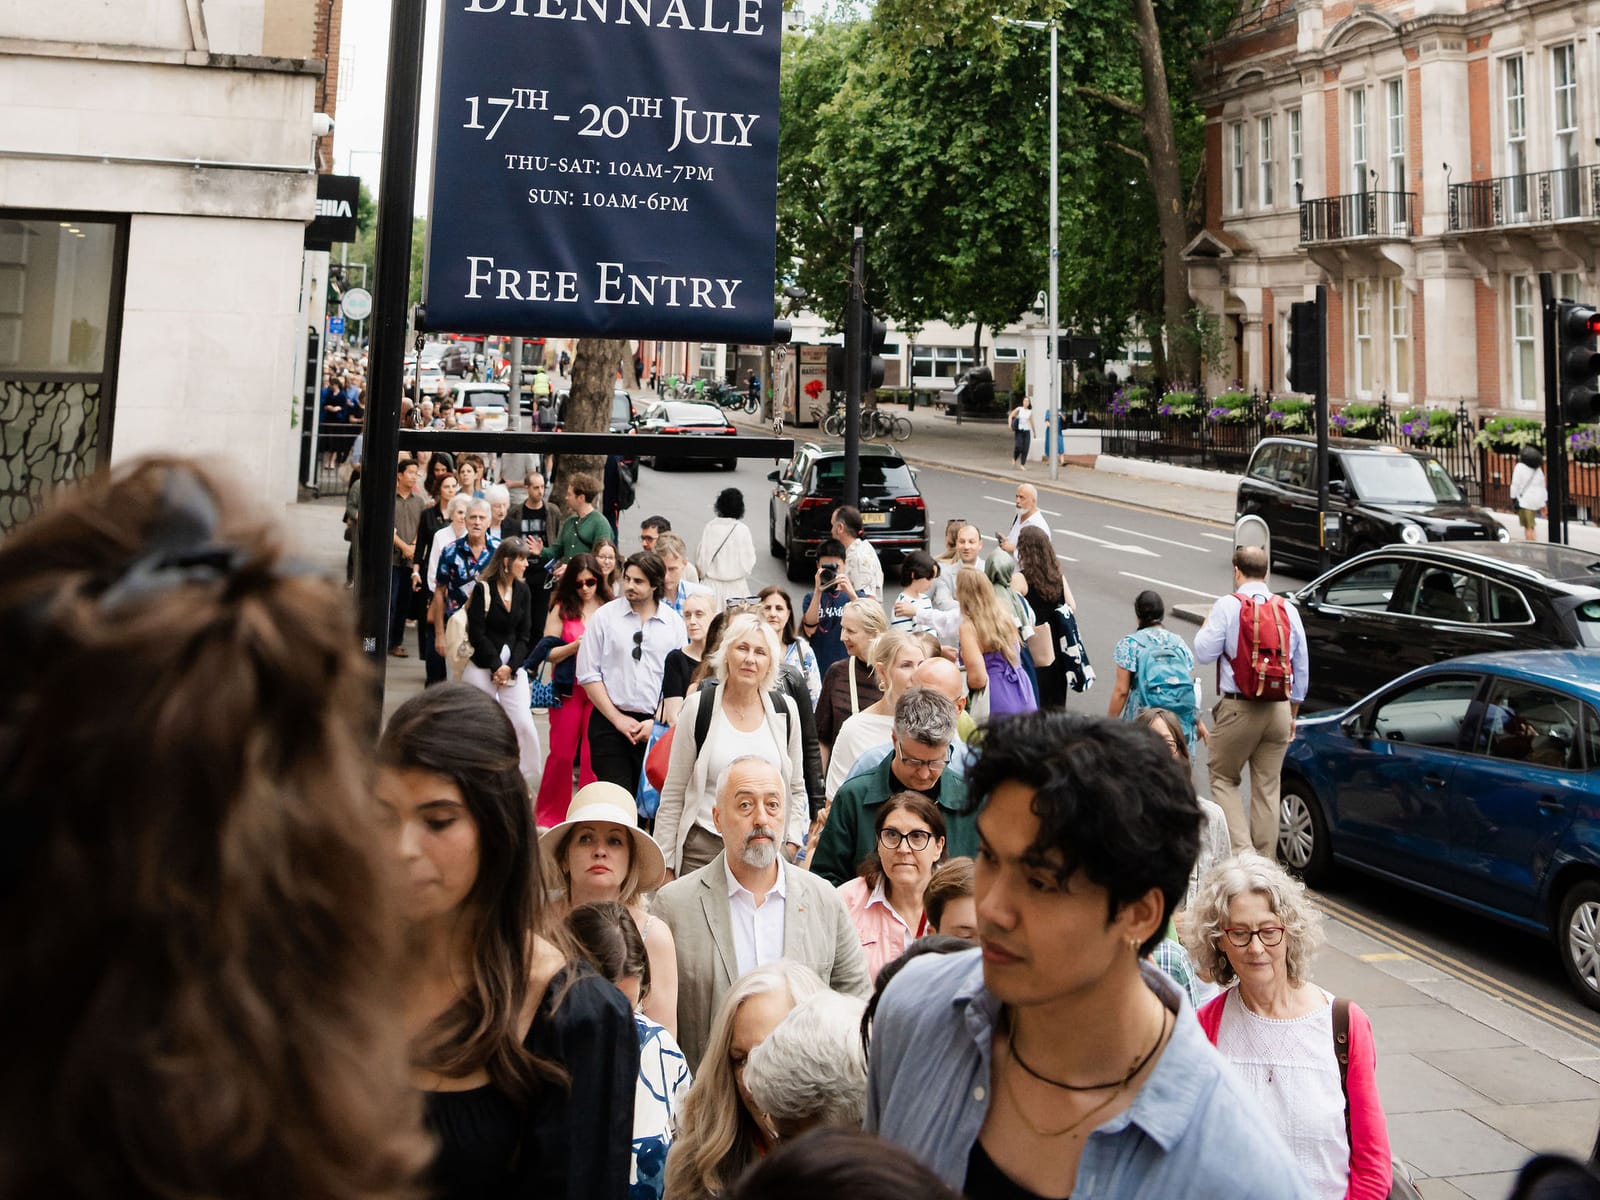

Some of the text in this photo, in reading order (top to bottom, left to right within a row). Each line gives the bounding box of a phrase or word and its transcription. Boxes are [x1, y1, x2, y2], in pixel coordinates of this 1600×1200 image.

[667, 96, 760, 152] JULY
[504, 154, 714, 183] THU-SAT: 10AM-7PM
[528, 188, 689, 212] SUN: 10AM-6PM
[464, 256, 742, 309] FREE ENTRY
